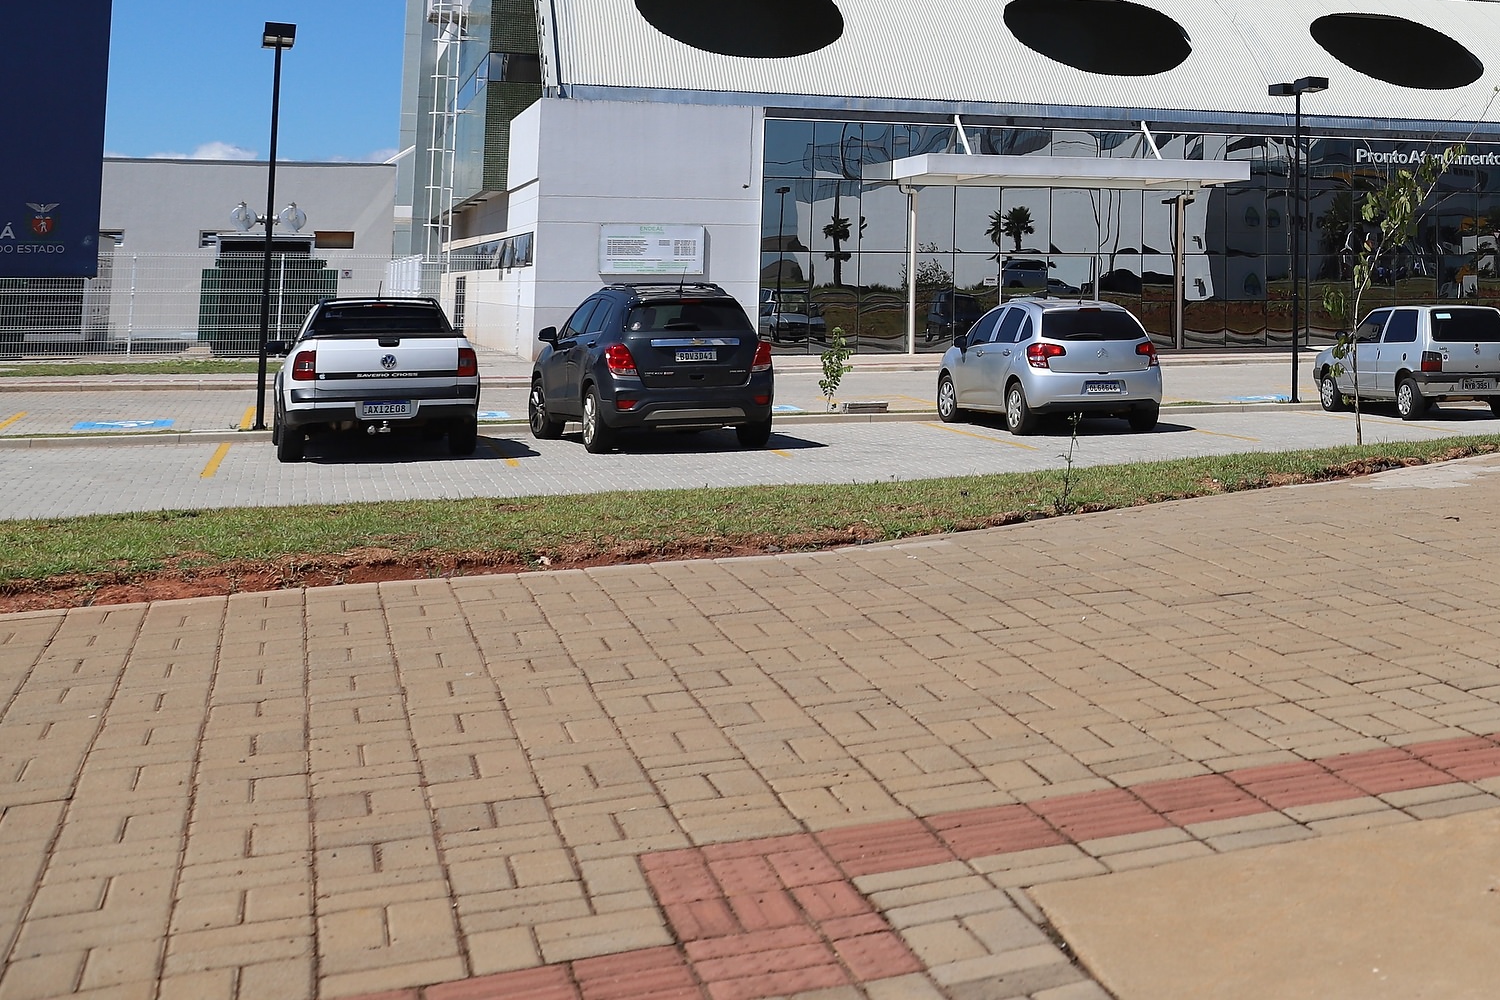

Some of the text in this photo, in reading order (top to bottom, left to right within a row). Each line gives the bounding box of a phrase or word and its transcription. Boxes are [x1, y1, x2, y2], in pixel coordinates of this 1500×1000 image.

[1356, 149, 1408, 164] Pronto
[17, 244, 65, 254] ESTADO
[367, 405, 407, 414] AXI2E08
